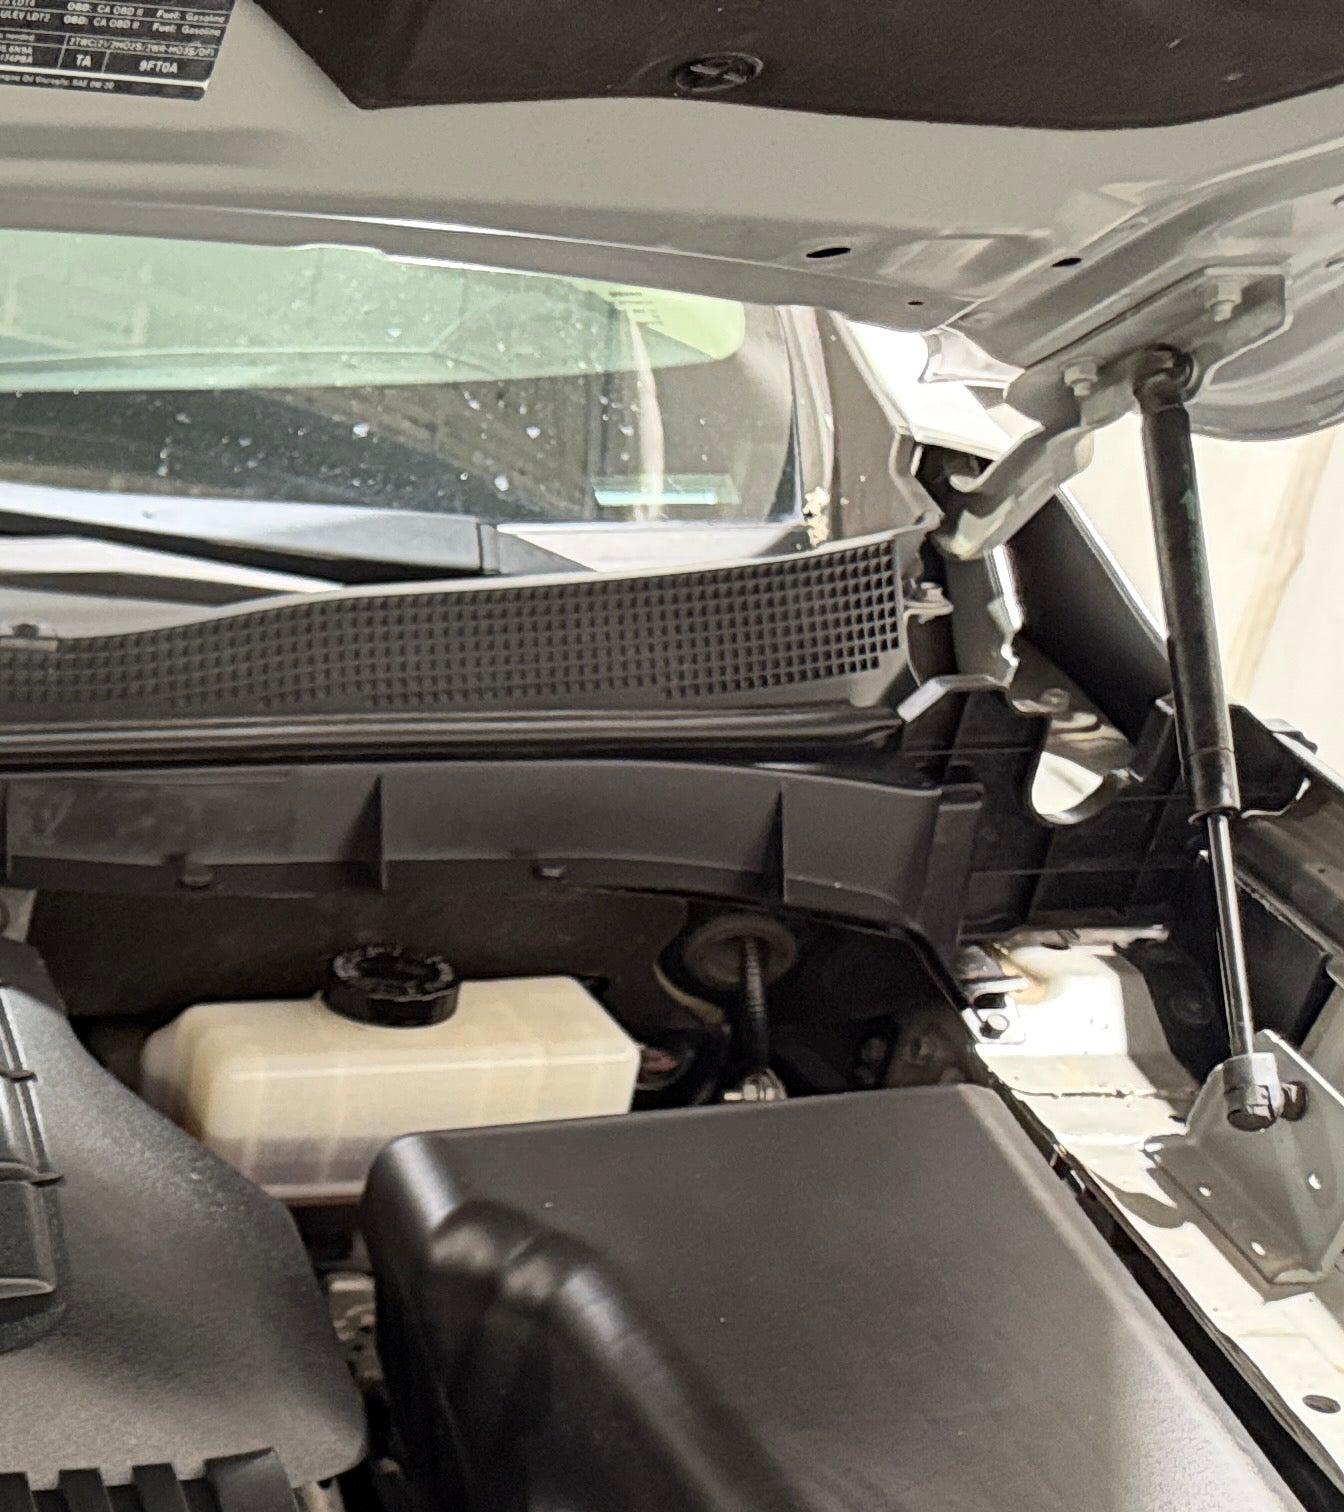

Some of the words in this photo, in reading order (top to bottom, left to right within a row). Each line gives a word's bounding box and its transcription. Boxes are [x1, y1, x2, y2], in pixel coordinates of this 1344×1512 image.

[97, 5, 111, 14] CA
[113, 6, 135, 16] OBD
[156, 10, 181, 19] Fuel:
[186, 12, 226, 23] Gasoline
[93, 17, 107, 27] CA
[109, 19, 131, 29] OBD
[182, 25, 221, 37] Gasoline
[76, 55, 92, 67] TA
